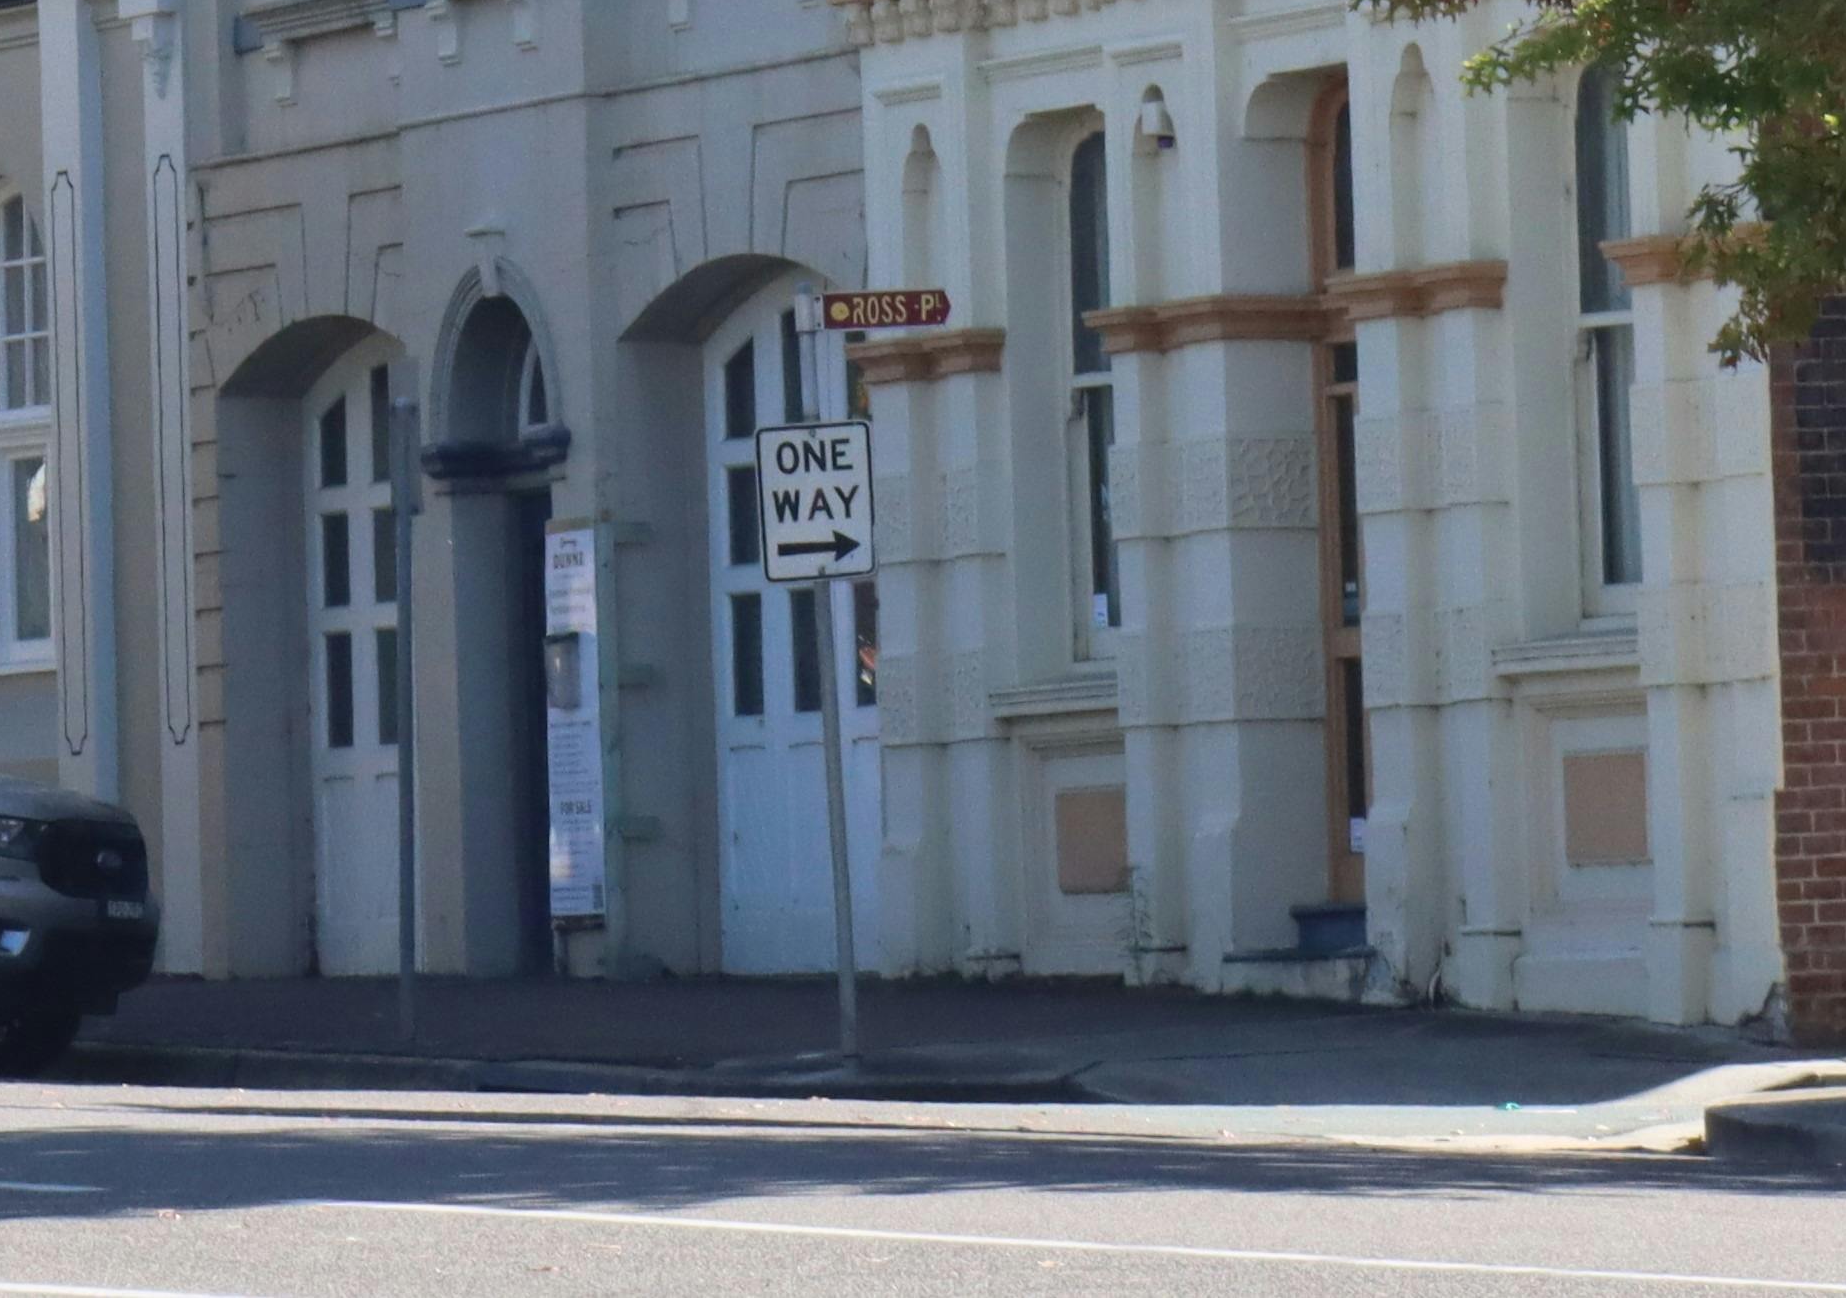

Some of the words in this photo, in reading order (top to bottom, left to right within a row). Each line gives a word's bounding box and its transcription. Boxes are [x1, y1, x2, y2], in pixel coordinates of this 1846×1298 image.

[852, 294, 907, 324] ROSS
[776, 438, 854, 475] ONE
[772, 485, 860, 524] WAY
